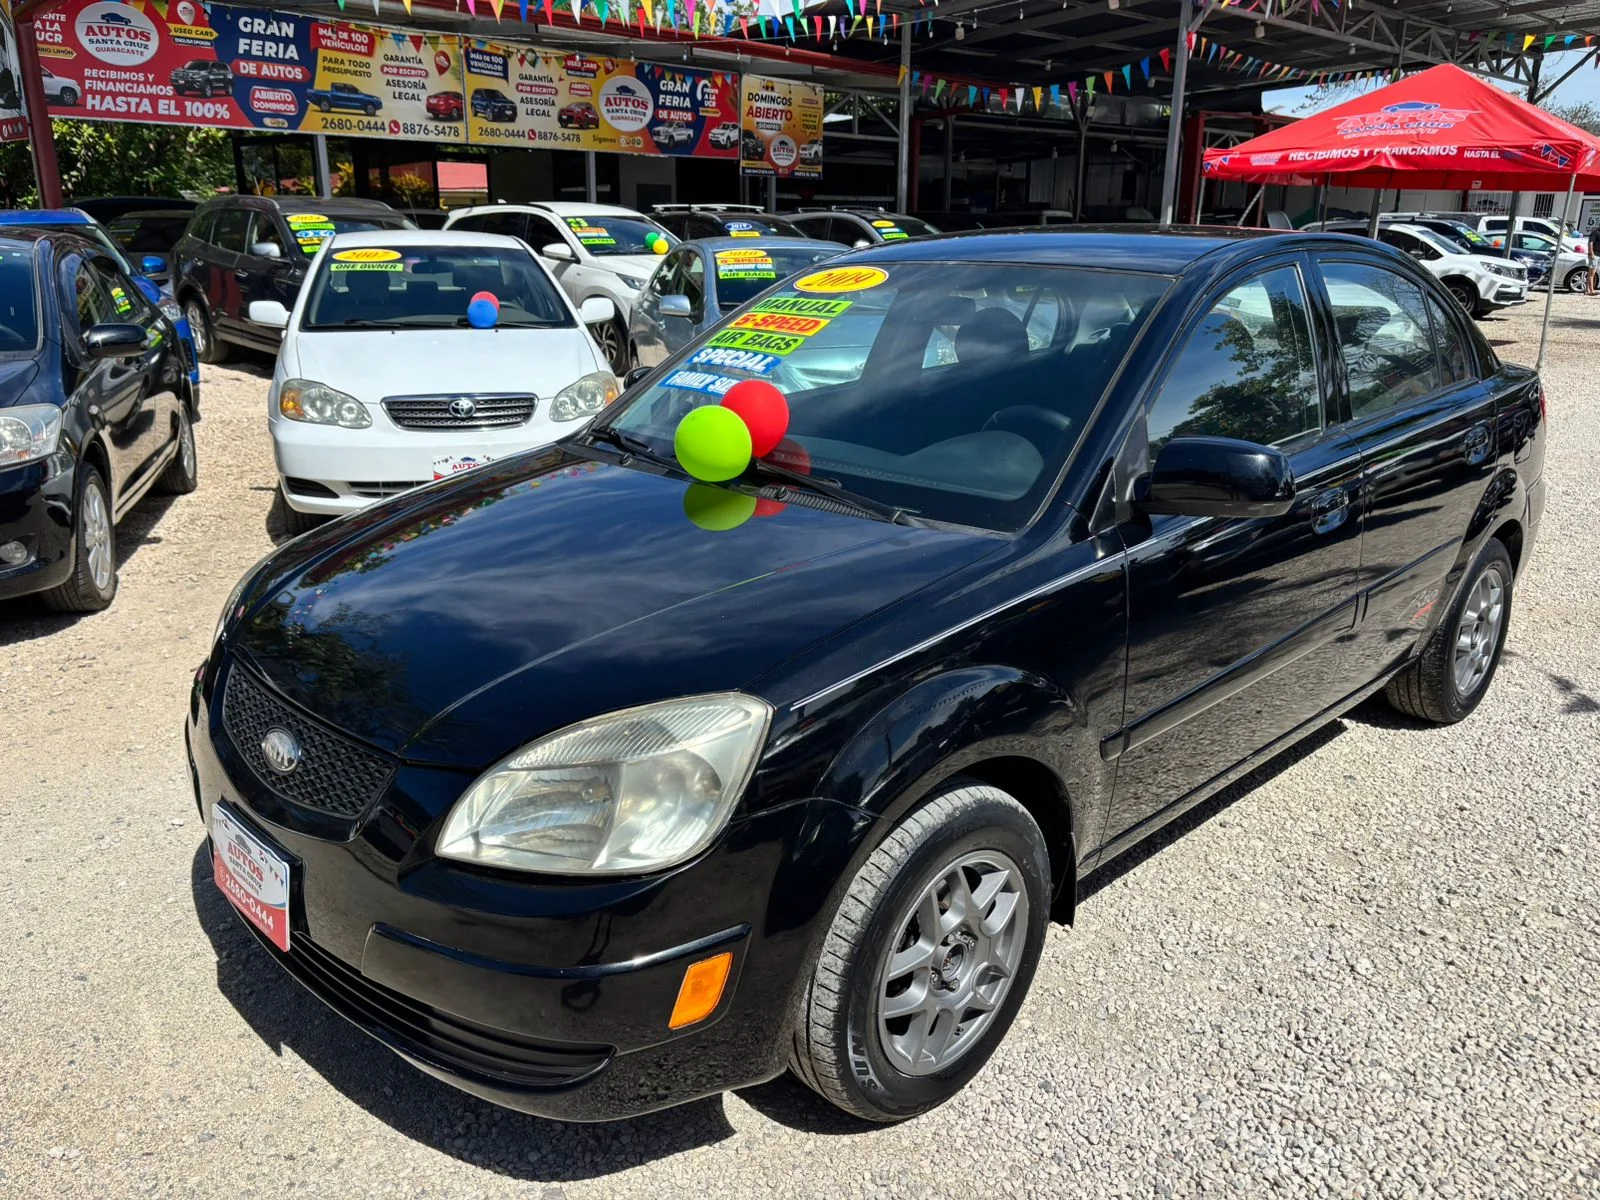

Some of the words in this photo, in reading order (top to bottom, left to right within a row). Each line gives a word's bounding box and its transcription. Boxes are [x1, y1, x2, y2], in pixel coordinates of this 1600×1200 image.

[34, 20, 43, 30] A
[46, 21, 61, 32] LA
[239, 16, 294, 38] GRAN
[36, 31, 63, 43] UCR
[85, 25, 152, 42] AUTOS
[338, 31, 349, 40] DE
[351, 32, 368, 44] 100
[88, 38, 122, 46] SANTA
[124, 41, 150, 50] CRUZ
[96, 46, 145, 56] GUANACASTE
[238, 38, 299, 60] FERIA
[320, 38, 368, 53] VEHÍCULOS!
[322, 56, 345, 66] PARA
[348, 59, 371, 69] TODO
[383, 54, 424, 65] GARANTÍA
[491, 56, 503, 64] 100
[84, 68, 144, 81] RECIBIMOS
[148, 74, 155, 82] Y
[240, 62, 257, 74] DE
[261, 64, 302, 79] AUTOS
[322, 66, 372, 78] PRESUPUESTO
[399, 68, 426, 77] ESCRITO
[386, 78, 427, 90] ASESORÍA
[519, 73, 554, 83] GARANTÍA
[85, 80, 174, 96] FINANCIAMOS
[532, 86, 555, 94] ESCRITO
[660, 80, 690, 93] GRAN
[255, 90, 292, 102] ABIERTO
[392, 91, 422, 102] LEGAL
[520, 96, 556, 107] ASESORÍA
[659, 95, 691, 108] FERIA
[748, 92, 792, 106] DOMINGOS
[86, 94, 153, 114] HASTA
[158, 100, 180, 116] EL
[185, 102, 230, 119] 100%
[253, 101, 296, 112] DOMINGOS
[605, 97, 649, 110] AUTOS
[526, 108, 551, 117] LEGAL
[659, 110, 669, 119] DE
[670, 112, 692, 121] AUTOS
[746, 106, 792, 121] ABIERTO
[321, 117, 386, 132] 2680-0444
[402, 122, 459, 137] 8876-5478
[1336, 112, 1471, 129] AUTOS
[478, 127, 526, 138] 2680-0444
[538, 131, 581, 142] 8876-5478
[1288, 146, 1360, 161] RECIBIMOS
[1364, 148, 1372, 157] Y
[1464, 149, 1489, 158] HASTA
[1490, 150, 1500, 159] EL
[802, 272, 876, 286] 2009
[754, 299, 842, 314] MANUAL
[734, 314, 820, 332] 5-SPEED
[712, 331, 745, 344] AIR
[741, 334, 798, 350] BAGS
[693, 348, 774, 372] SPECIAL
[665, 371, 719, 389] FAMILY
[707, 377, 740, 394] SIZ
[228, 841, 264, 882] AUTOS
[229, 856, 246, 873] SANTA
[226, 874, 274, 930] 2680-0444
